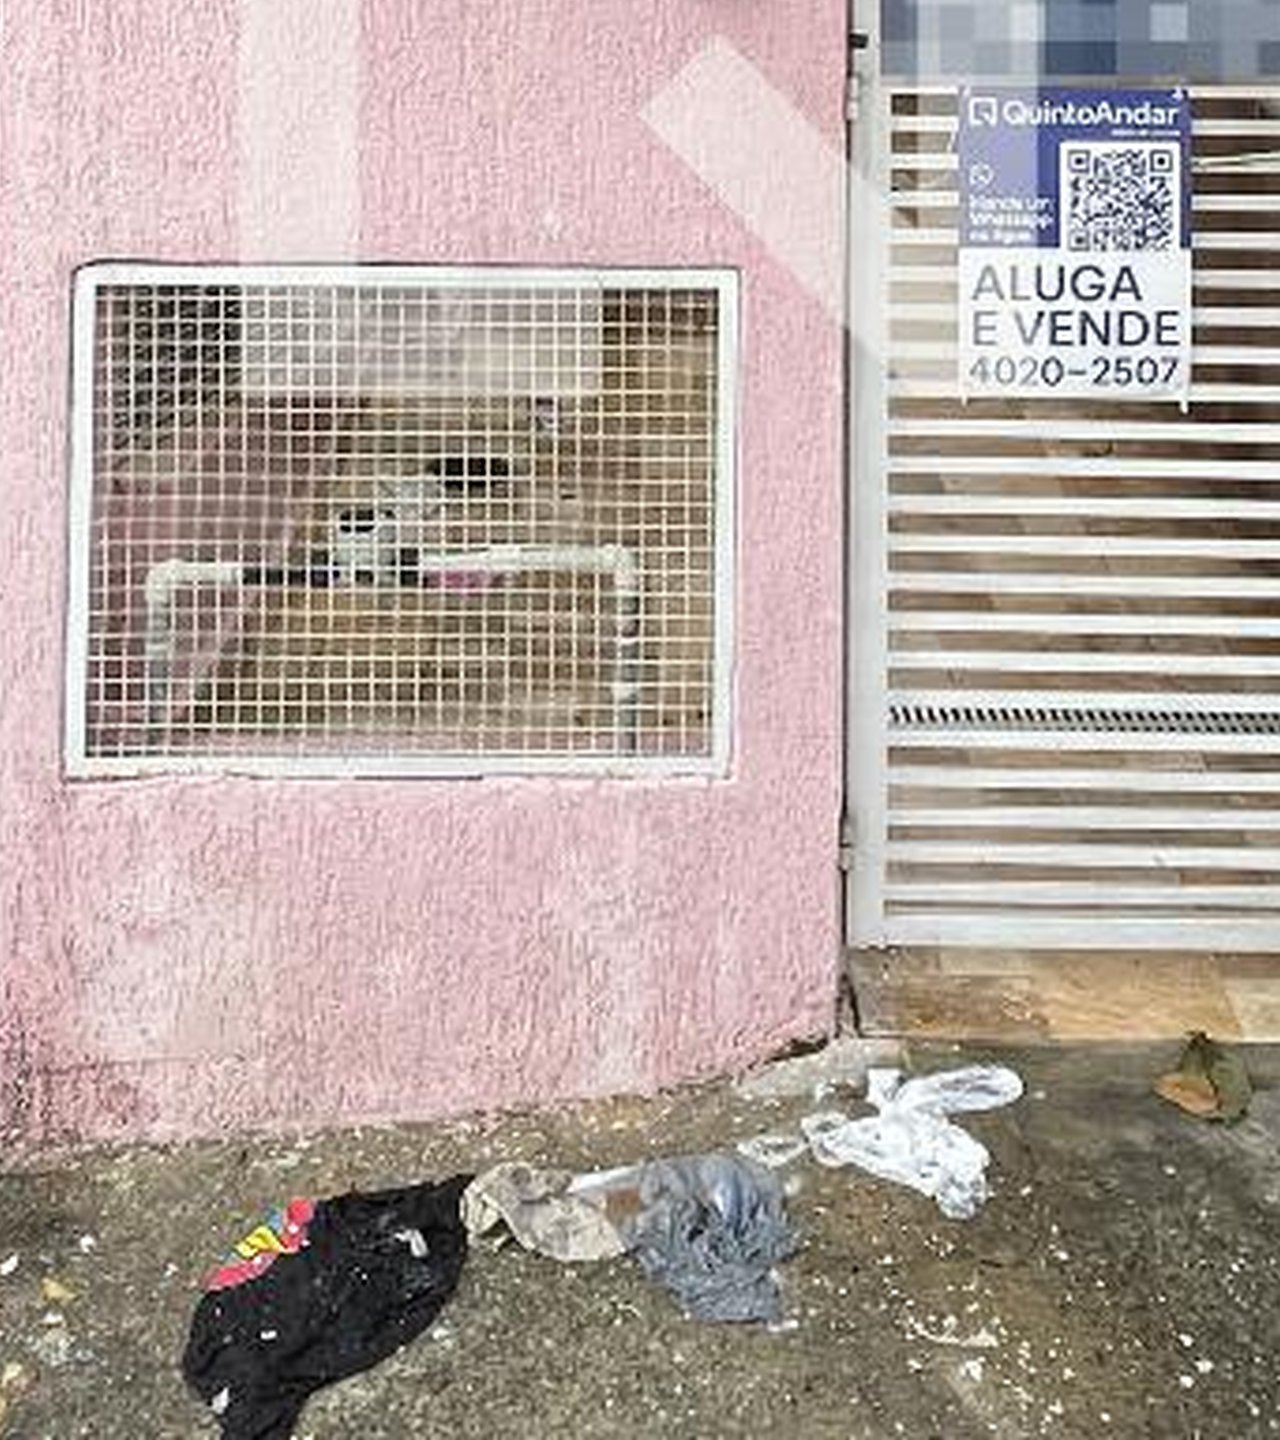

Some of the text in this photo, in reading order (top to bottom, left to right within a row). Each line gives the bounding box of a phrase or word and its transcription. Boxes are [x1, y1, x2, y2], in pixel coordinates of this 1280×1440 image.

[1003, 101, 1179, 126] QuintoAndar
[971, 264, 1143, 302] ALUGA
[973, 310, 1180, 346] E VENDE
[970, 357, 1179, 387] 4020-2507
